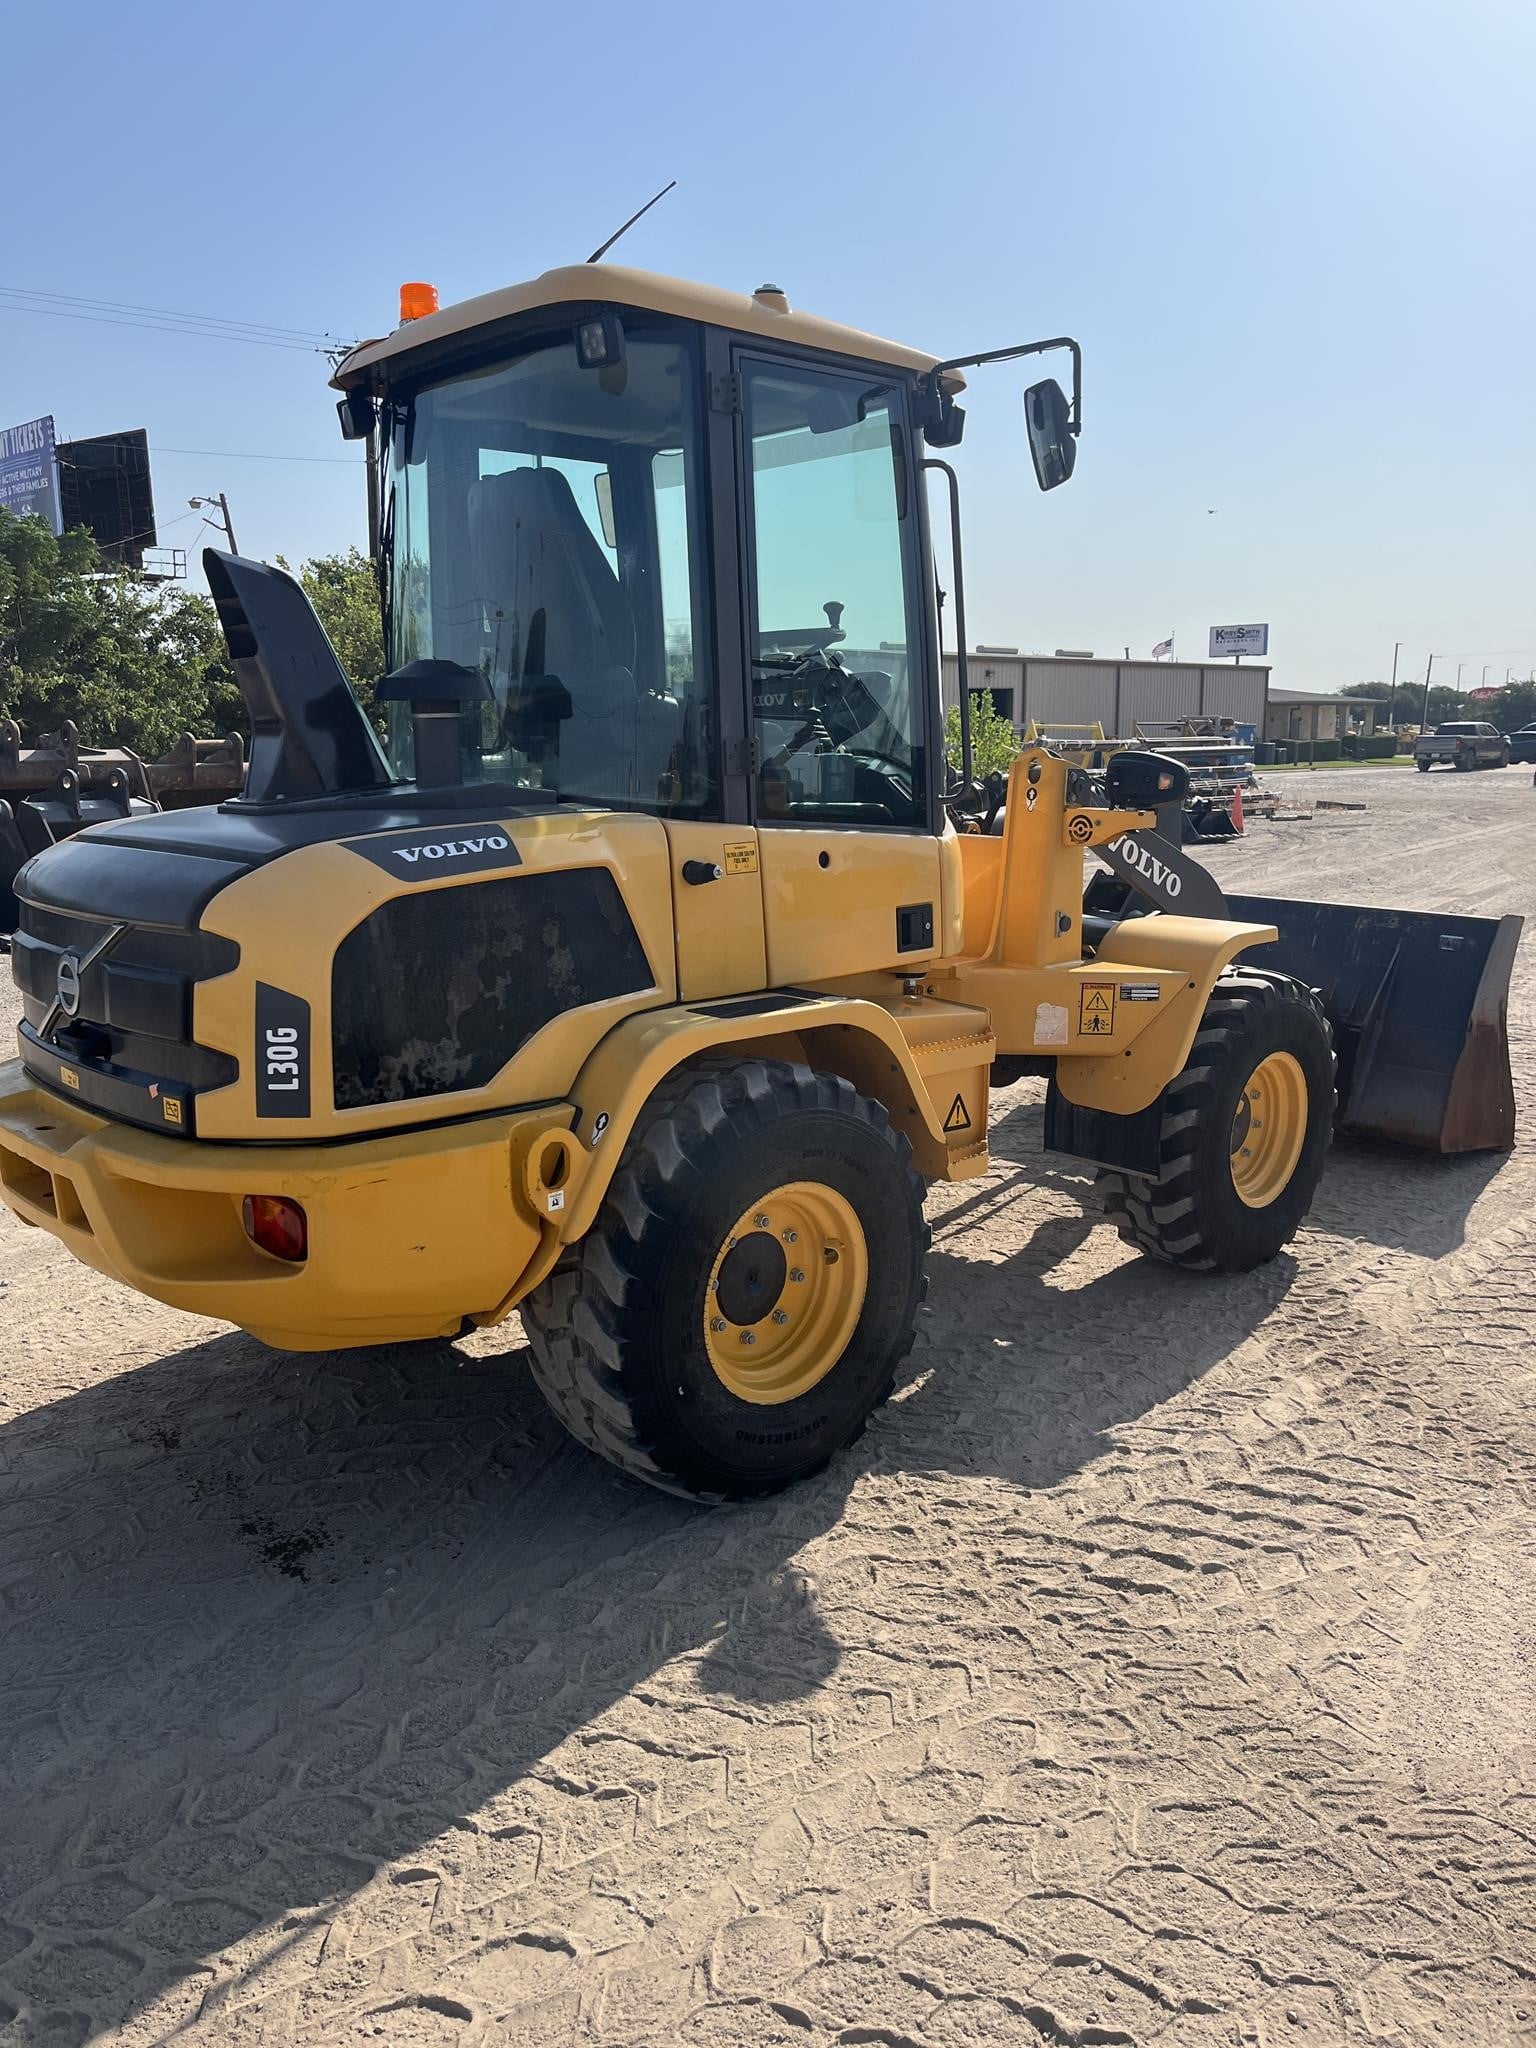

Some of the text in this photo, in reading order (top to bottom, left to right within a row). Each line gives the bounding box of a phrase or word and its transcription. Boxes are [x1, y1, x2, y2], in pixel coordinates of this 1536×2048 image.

[9, 420, 44, 454] TICKETS
[2, 465, 43, 484] ACTIVE MILITARY
[26, 478, 48, 492] FAMILIES
[392, 836, 508, 862] VOLVO
[266, 1027, 299, 1090] L30G
